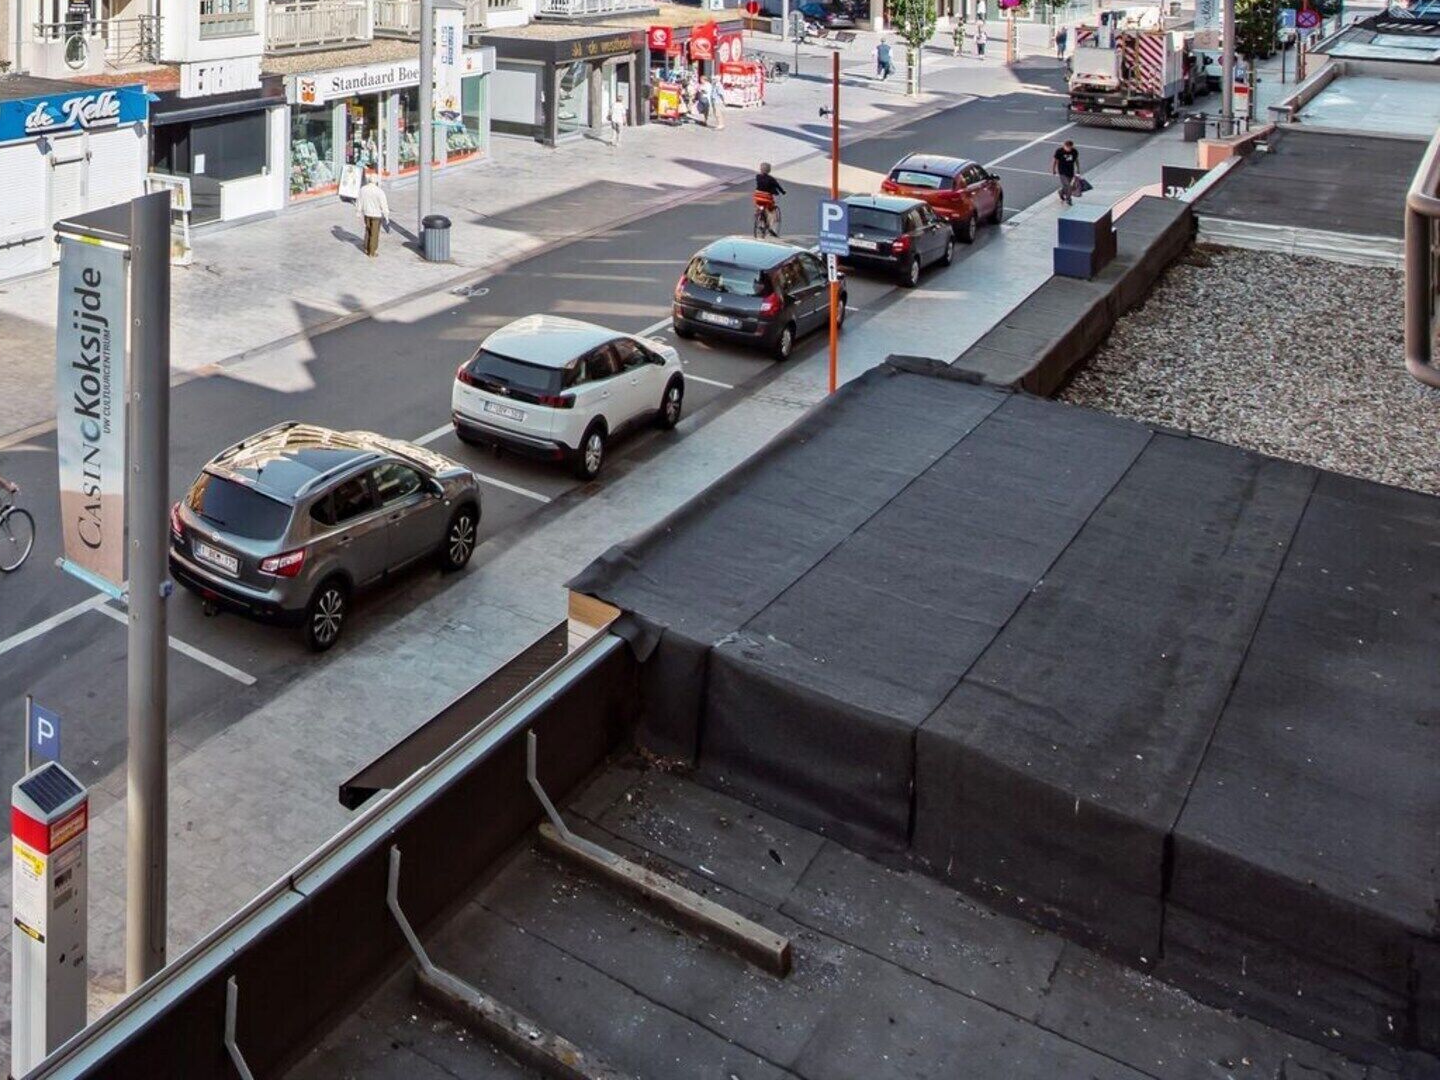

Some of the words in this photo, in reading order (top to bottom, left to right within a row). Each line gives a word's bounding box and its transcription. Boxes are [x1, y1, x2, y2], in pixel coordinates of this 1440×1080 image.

[331, 69, 395, 93] Standaard
[822, 203, 844, 231] P
[103, 328, 112, 417] CULTUURCENTRUM
[103, 417, 111, 434] UW
[38, 716, 55, 745] P
